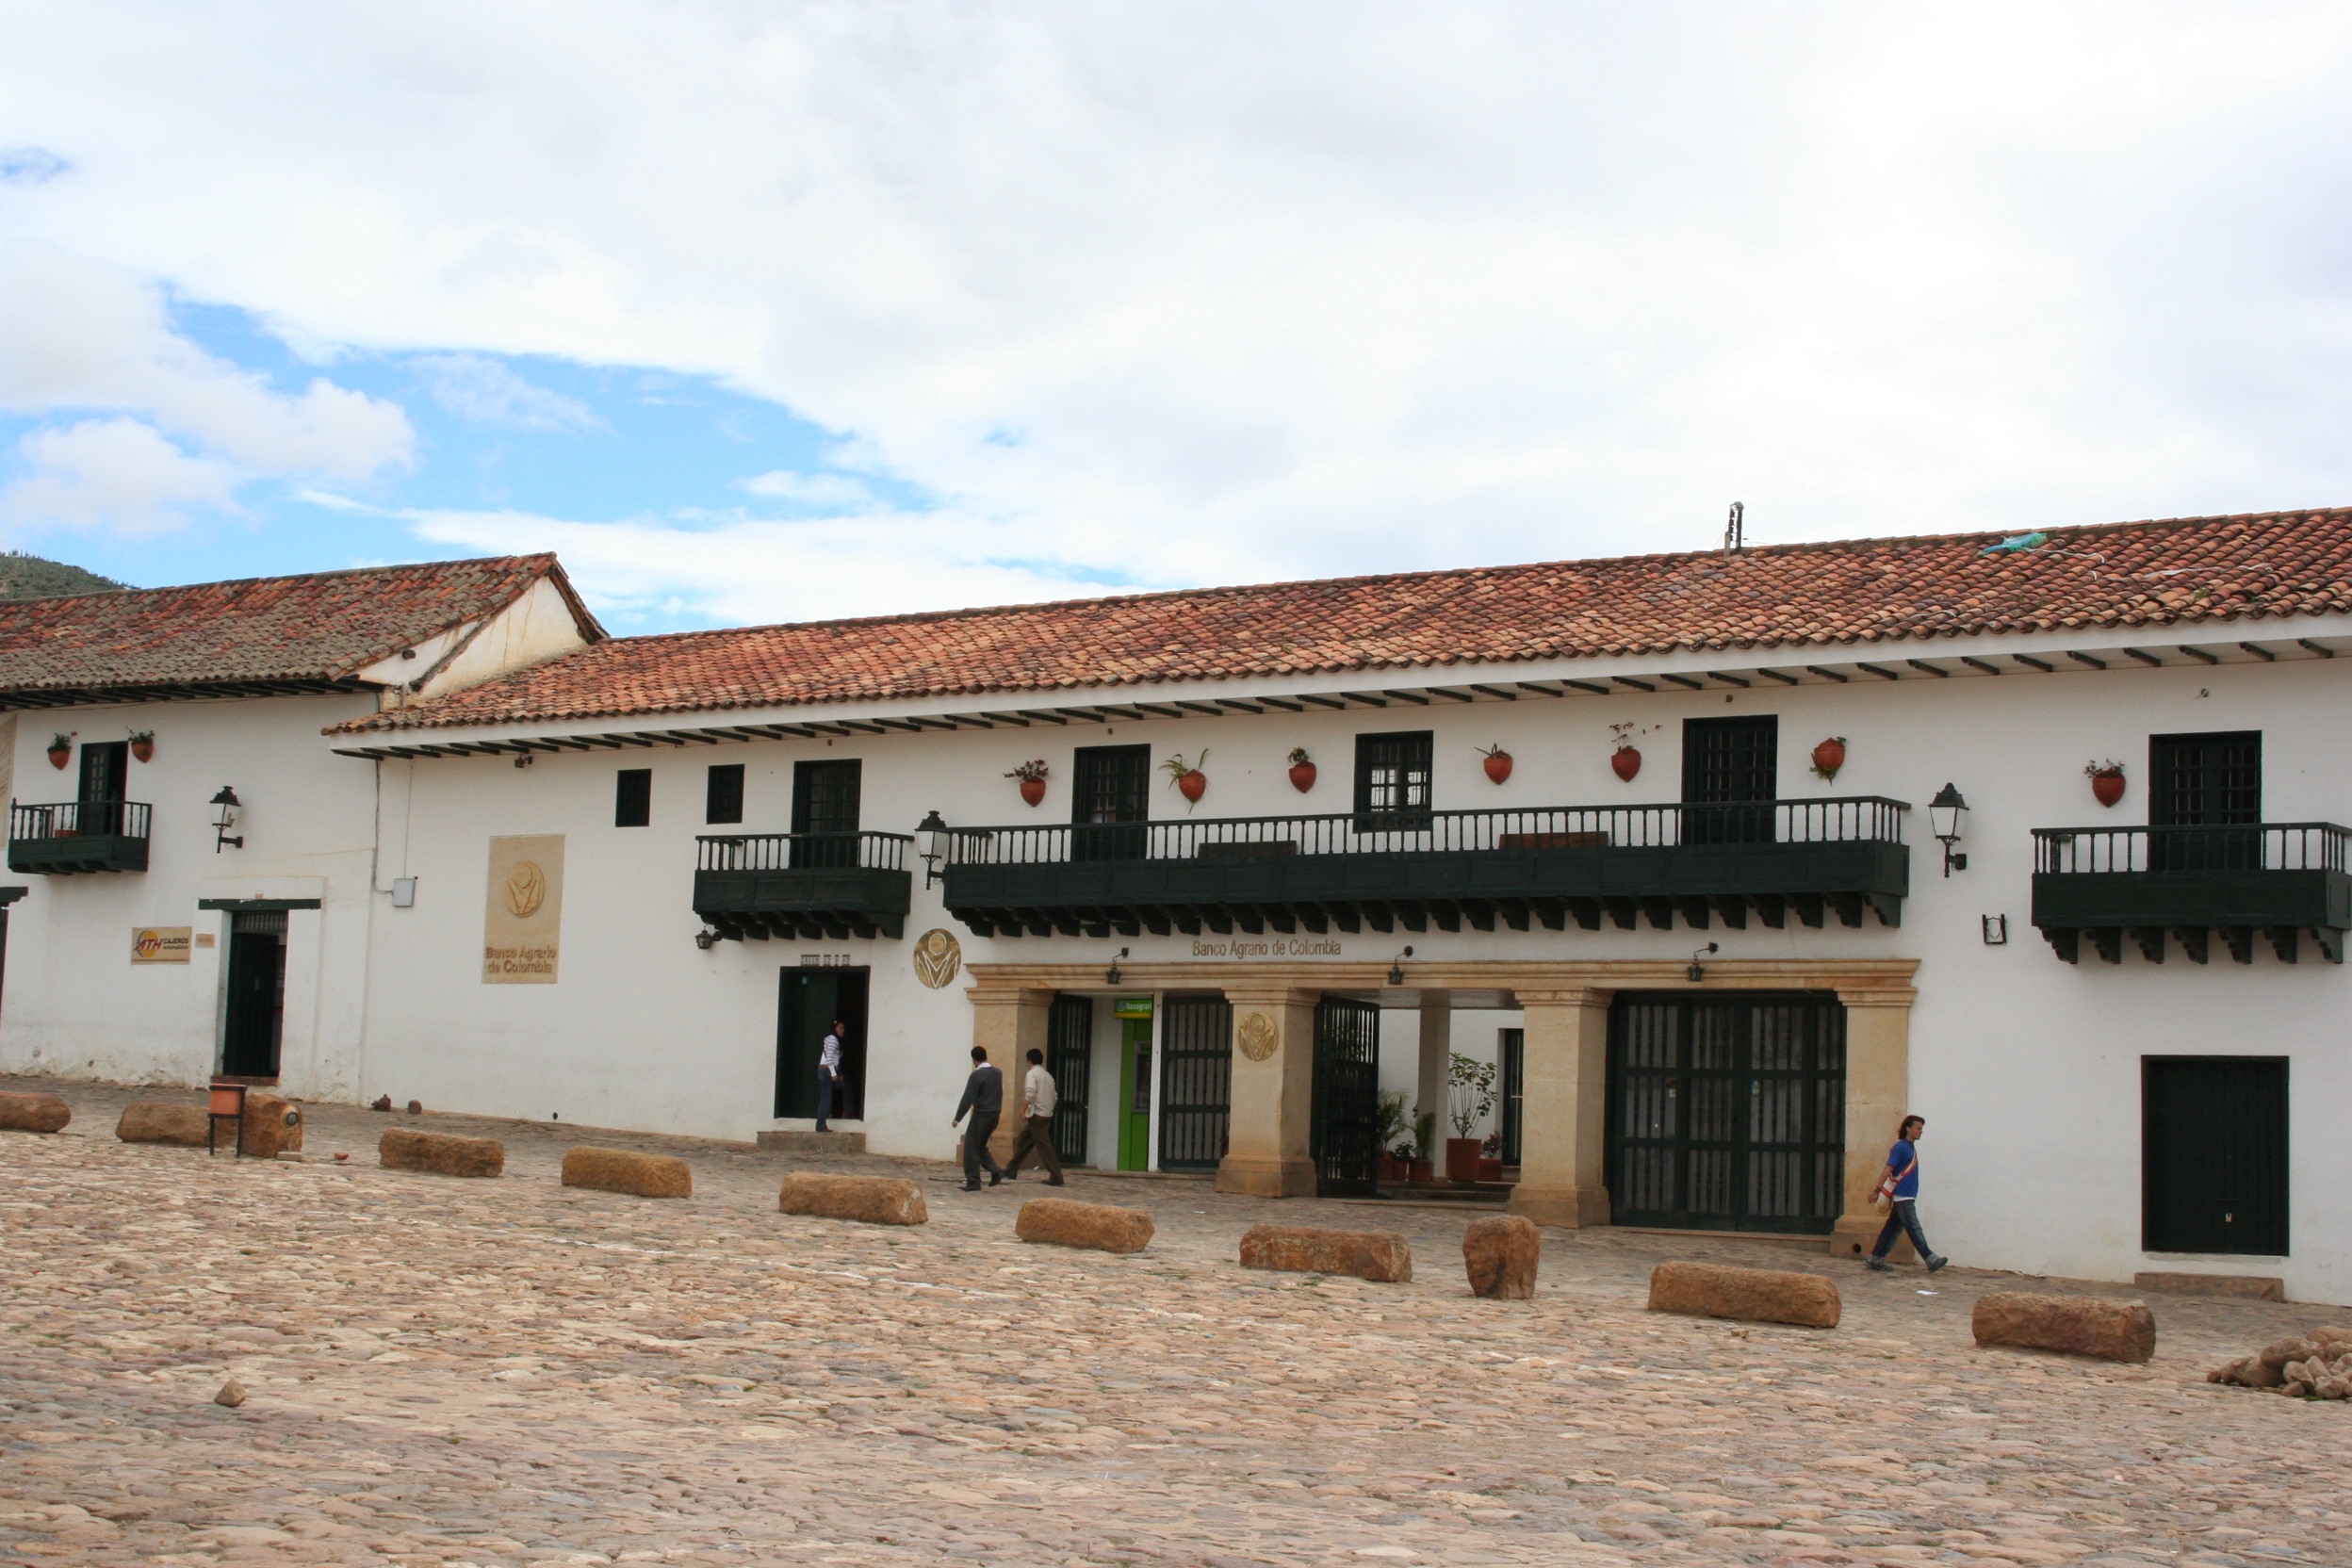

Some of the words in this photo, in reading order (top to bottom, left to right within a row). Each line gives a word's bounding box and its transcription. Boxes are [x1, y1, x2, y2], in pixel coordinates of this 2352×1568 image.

[135, 939, 163, 951] ATH
[486, 946, 517, 958] Banco
[518, 944, 557, 961] Agrario
[1192, 941, 1226, 956] Banco
[1230, 940, 1268, 959] Agrario
[1272, 940, 1285, 956] de
[1289, 939, 1341, 956] Colombia
[488, 961, 500, 973] de
[503, 960, 552, 973] Colombia
